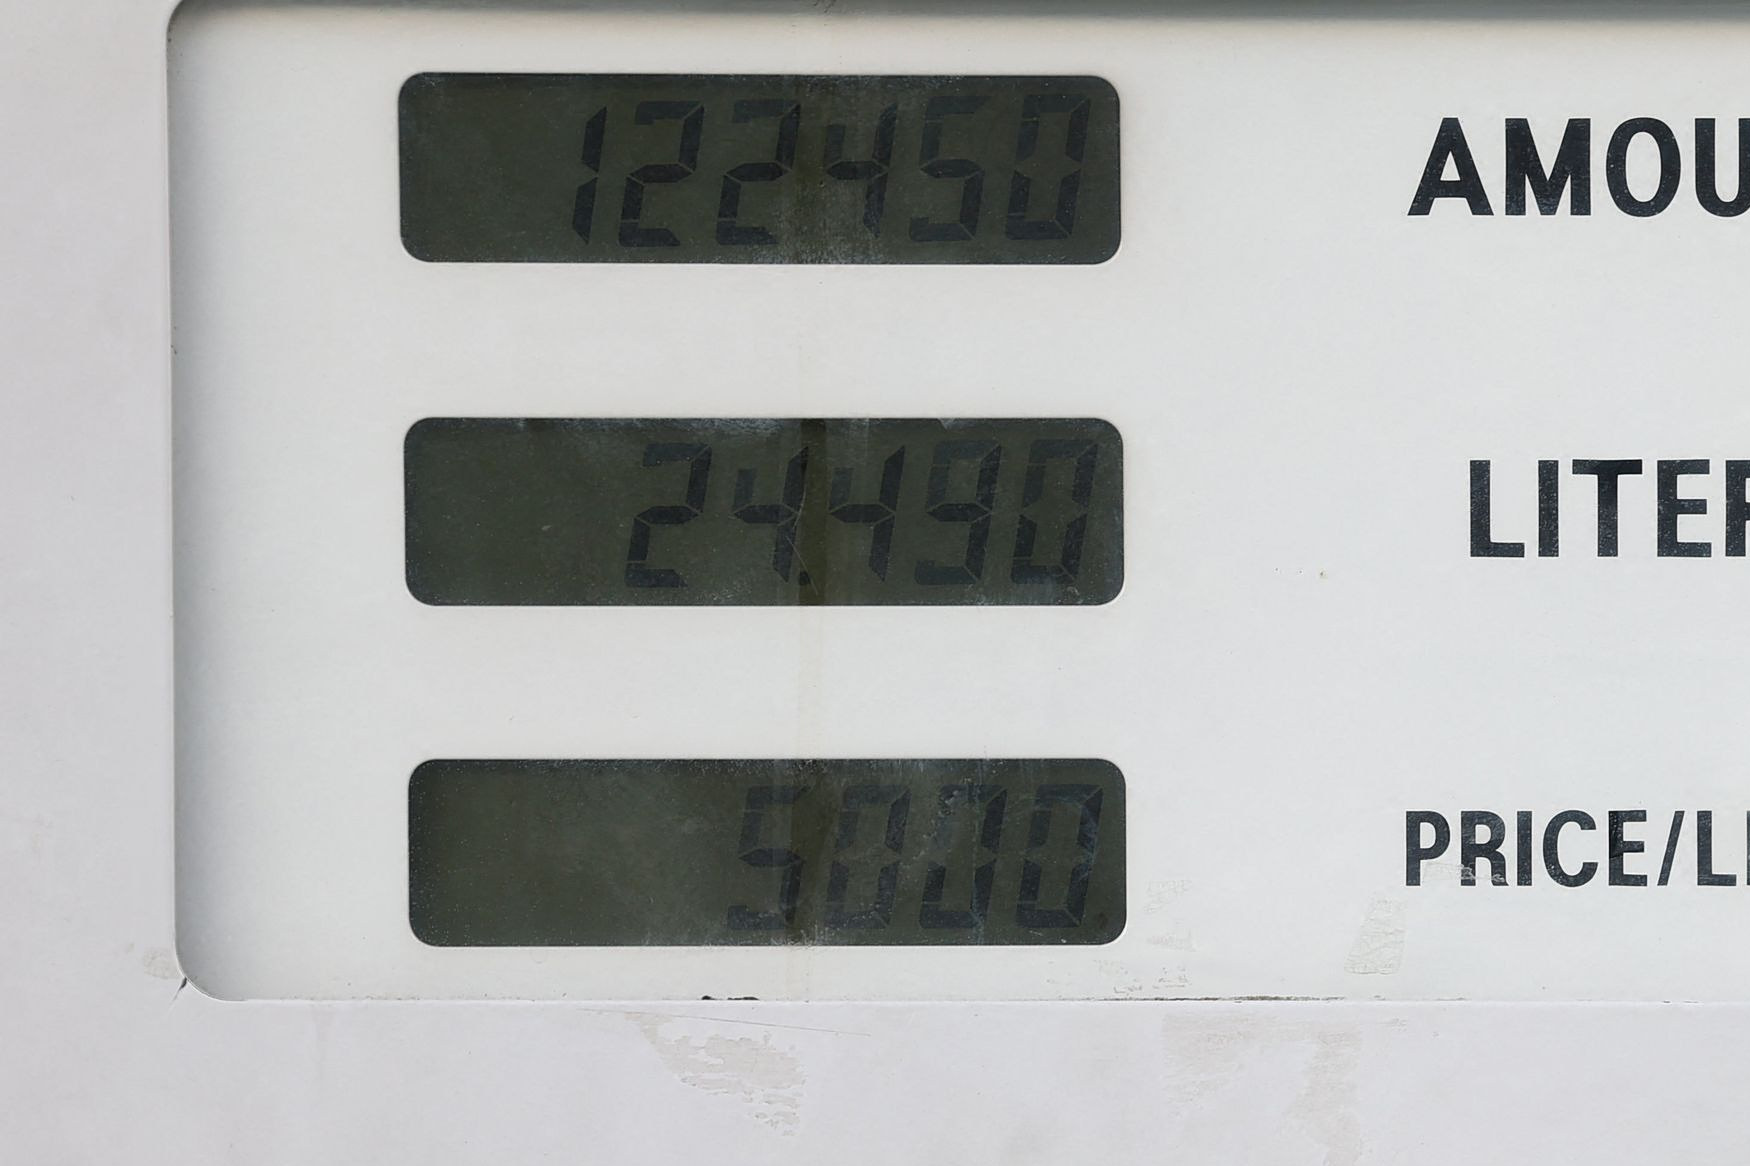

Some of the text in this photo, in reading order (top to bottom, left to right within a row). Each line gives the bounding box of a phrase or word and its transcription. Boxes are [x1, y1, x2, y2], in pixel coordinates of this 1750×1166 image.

[573, 94, 1091, 248] 122450
[624, 438, 1100, 590] 24.490
[726, 783, 1105, 931] 5000
